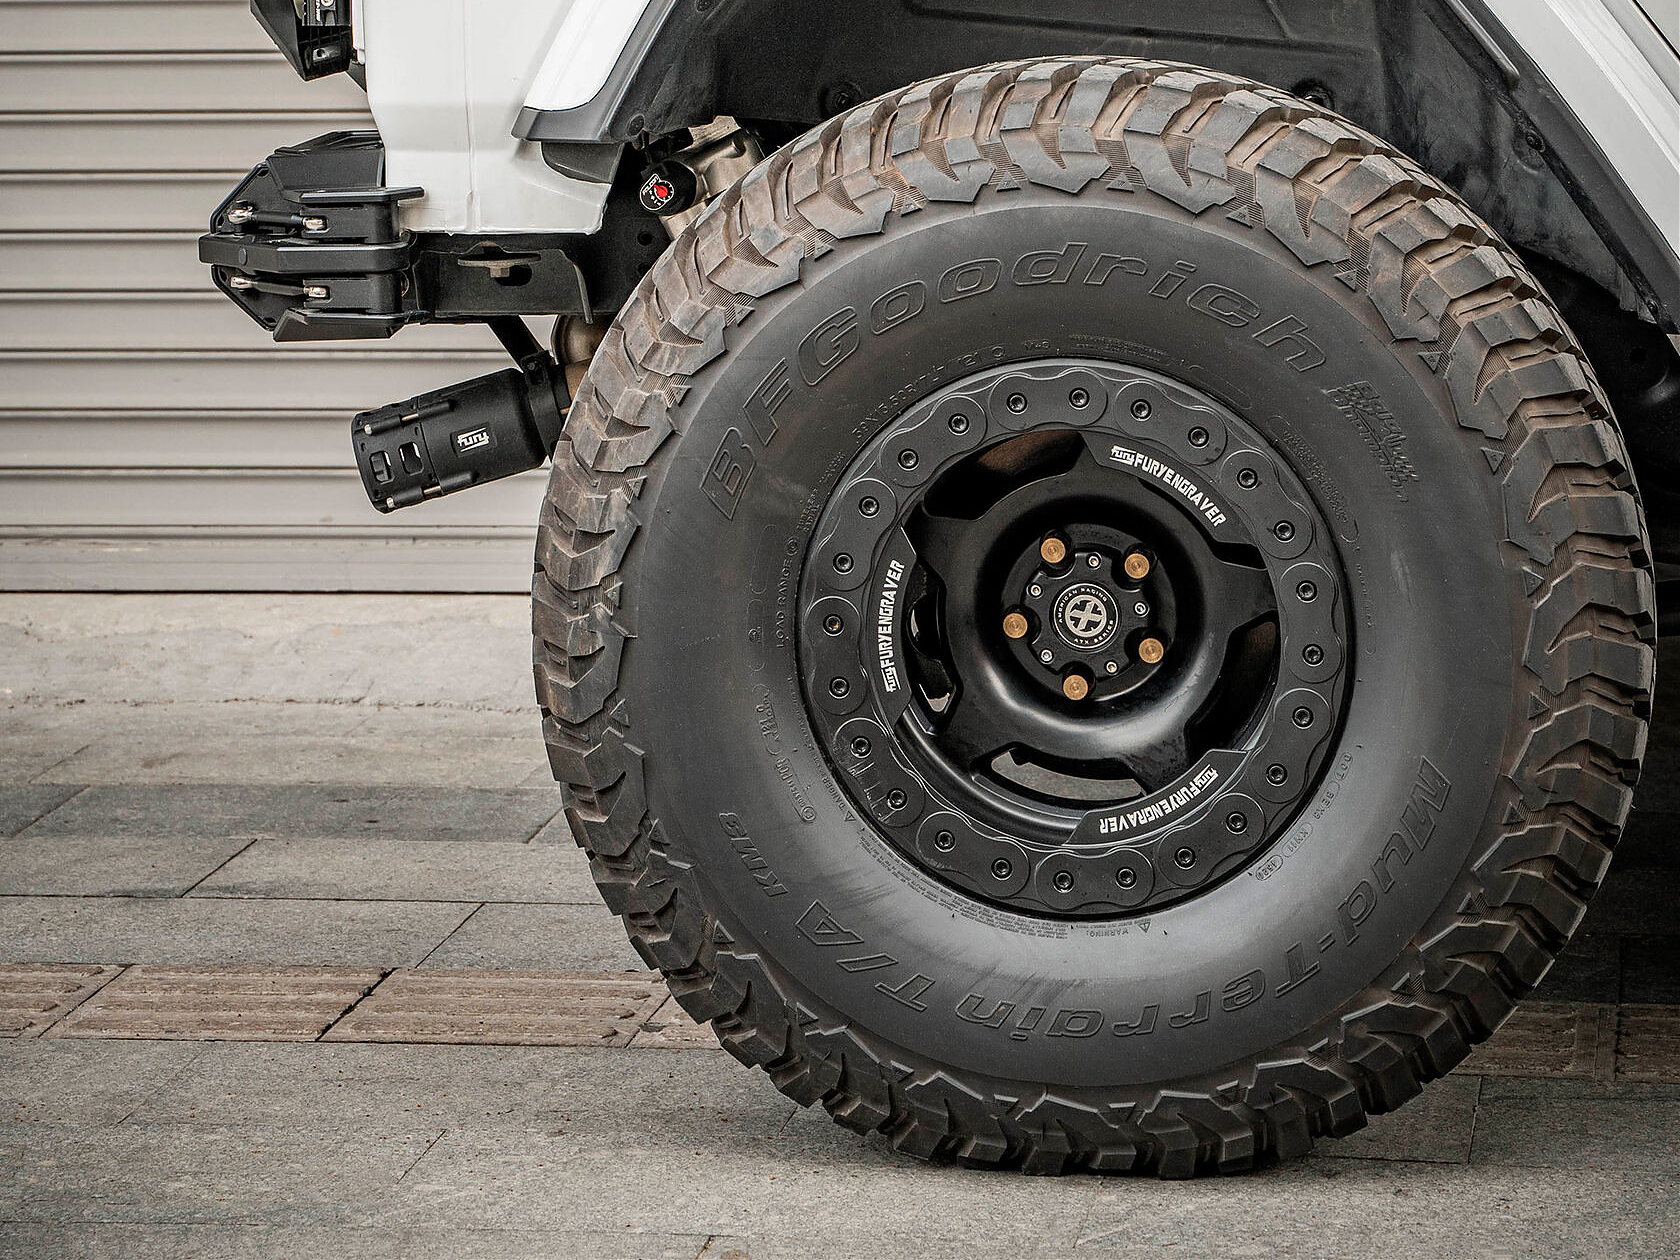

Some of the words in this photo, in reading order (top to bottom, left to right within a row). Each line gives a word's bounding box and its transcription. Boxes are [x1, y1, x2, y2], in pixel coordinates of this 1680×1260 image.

[701, 241, 1328, 521] BFGoodrich
[457, 427, 490, 452] fury
[1134, 453, 1227, 527] FURYENGRAVER
[877, 559, 905, 669] FURYENGRAVER
[1058, 589, 1078, 623] AMERICAN
[1080, 588, 1108, 602] RACING
[1093, 620, 1114, 643] SERIES
[820, 775, 847, 810] DANGER
[1099, 781, 1202, 834] FURYENGRAVER
[719, 810, 788, 898] KM3
[795, 899, 927, 1002] T/A
